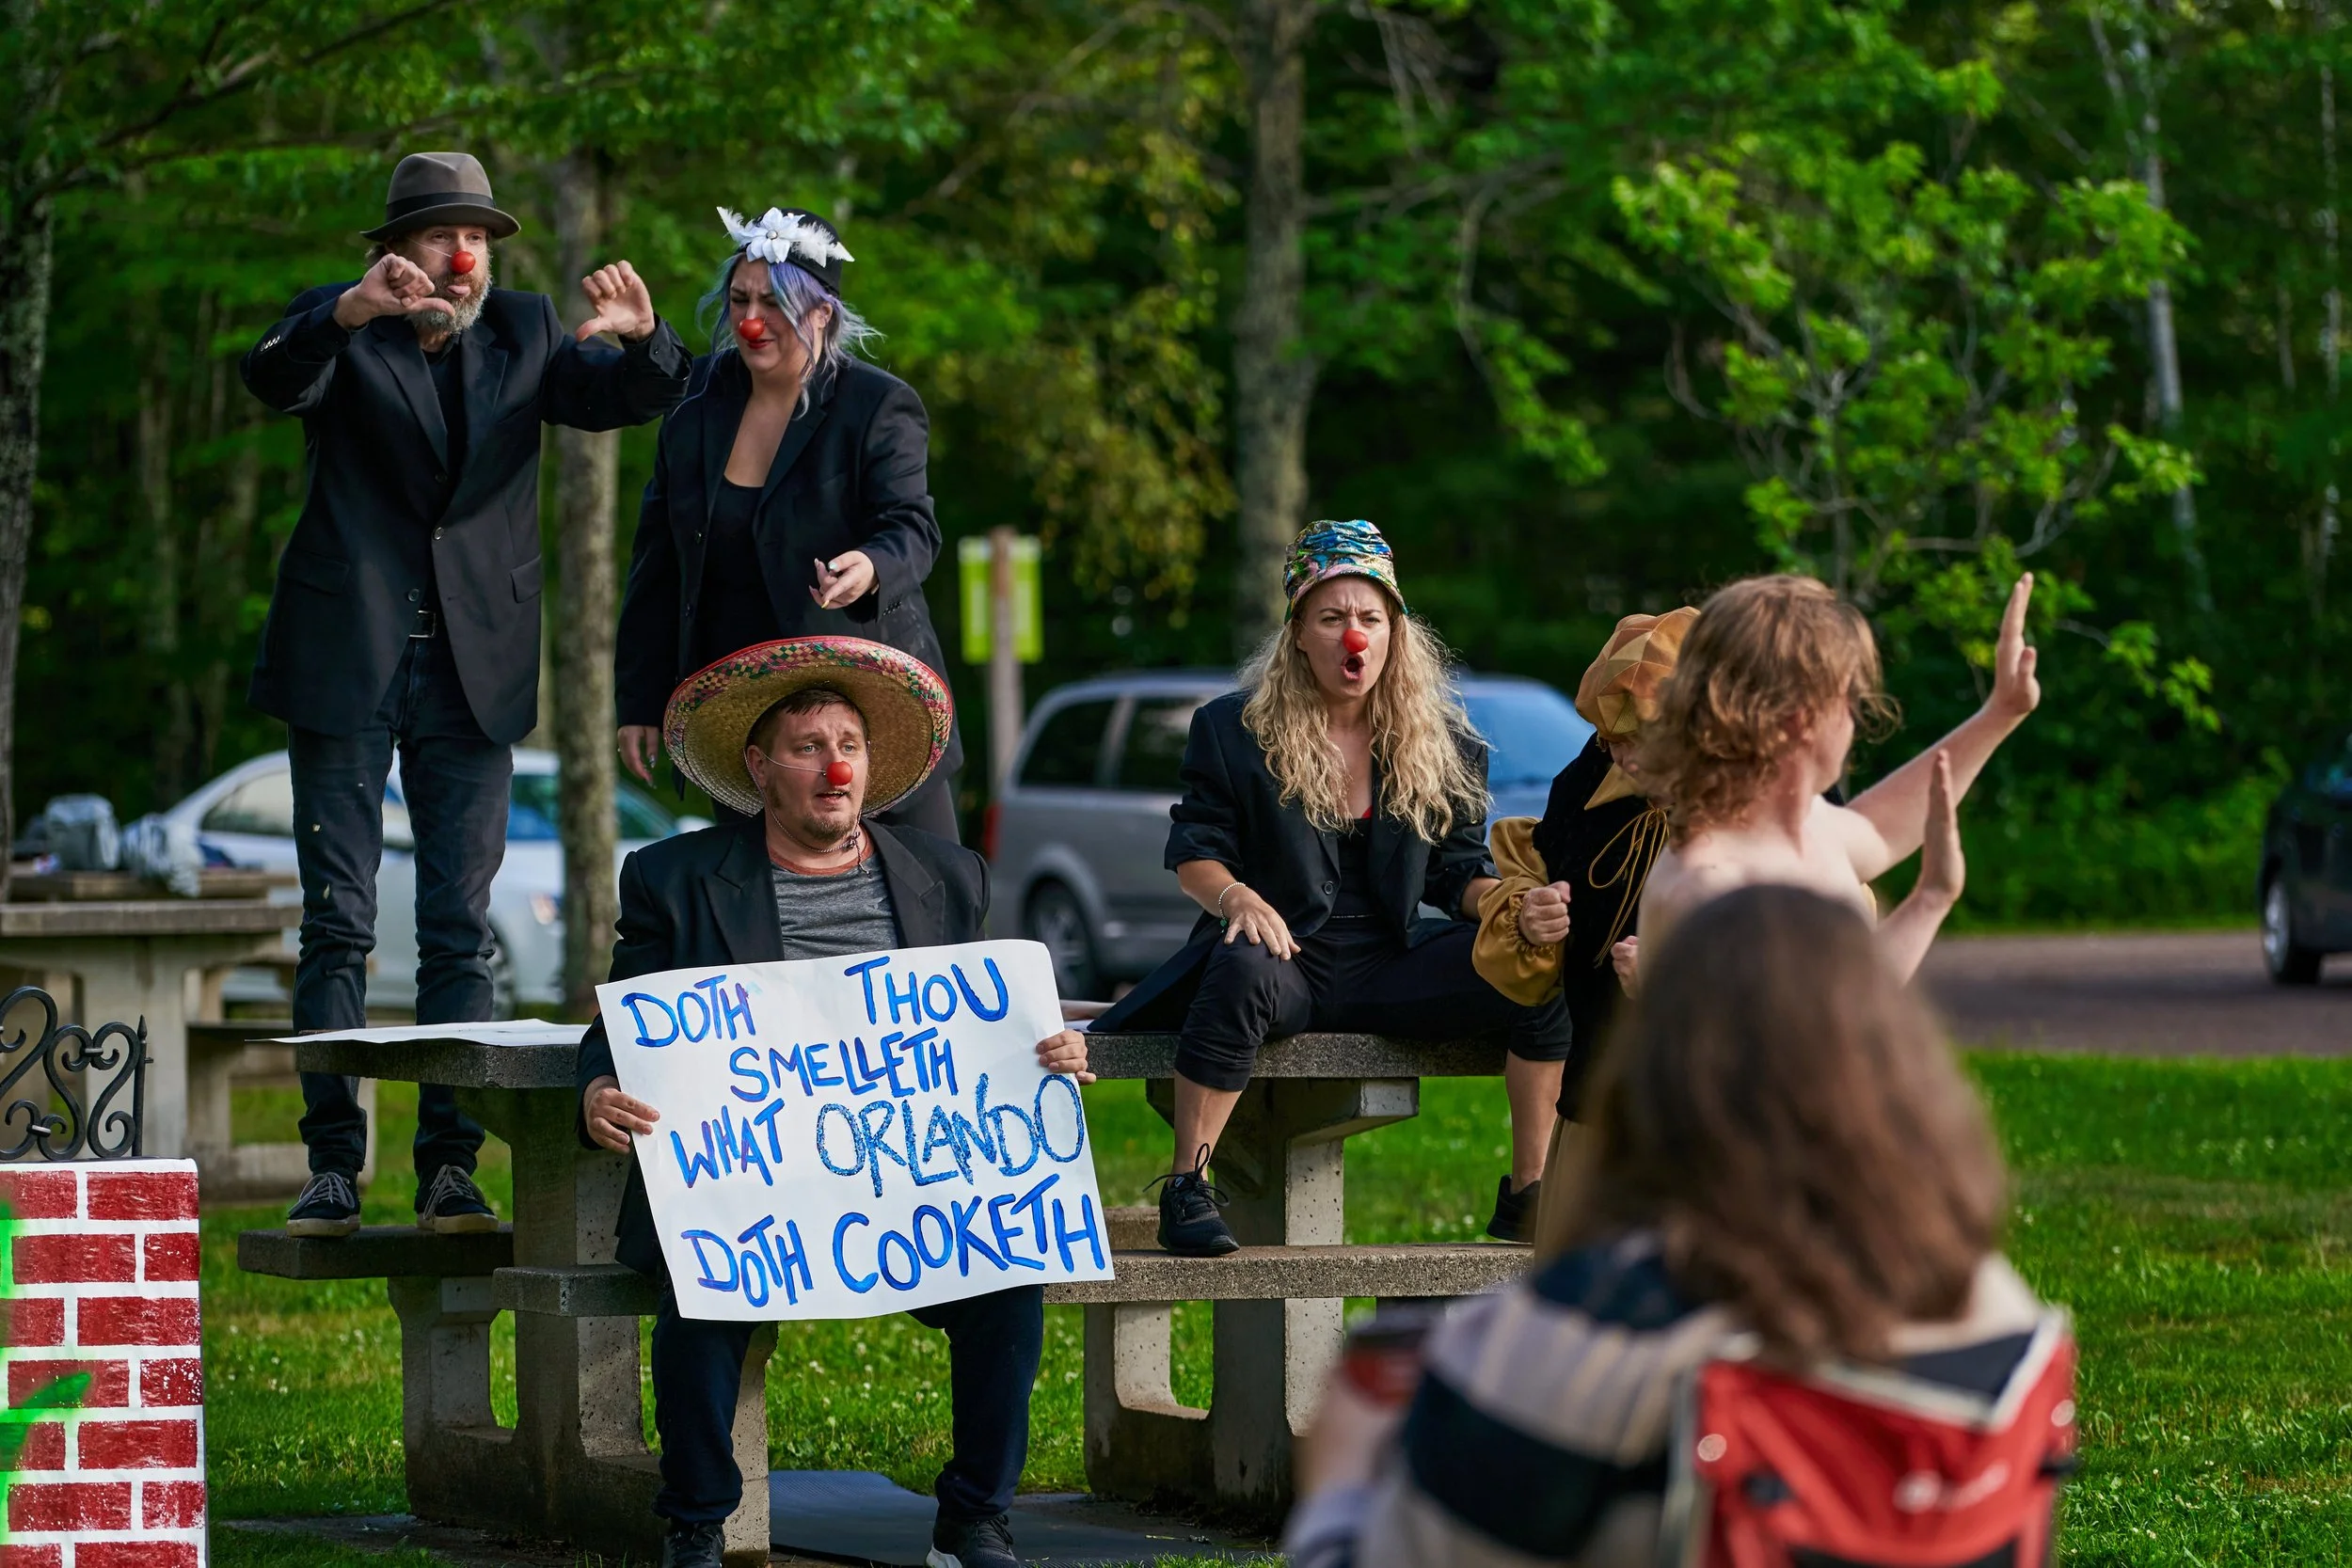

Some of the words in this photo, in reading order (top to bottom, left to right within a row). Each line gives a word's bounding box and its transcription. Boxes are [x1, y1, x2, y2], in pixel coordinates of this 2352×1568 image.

[622, 974, 756, 1048] DOTH
[844, 956, 1009, 1025] THOU
[729, 1028, 959, 1101] SMELLETH
[670, 1098, 785, 1188] WHAT
[816, 1073, 1085, 1198] ORLANDO
[681, 1213, 815, 1308] DOTH
[833, 1173, 1105, 1292] COOKETH
